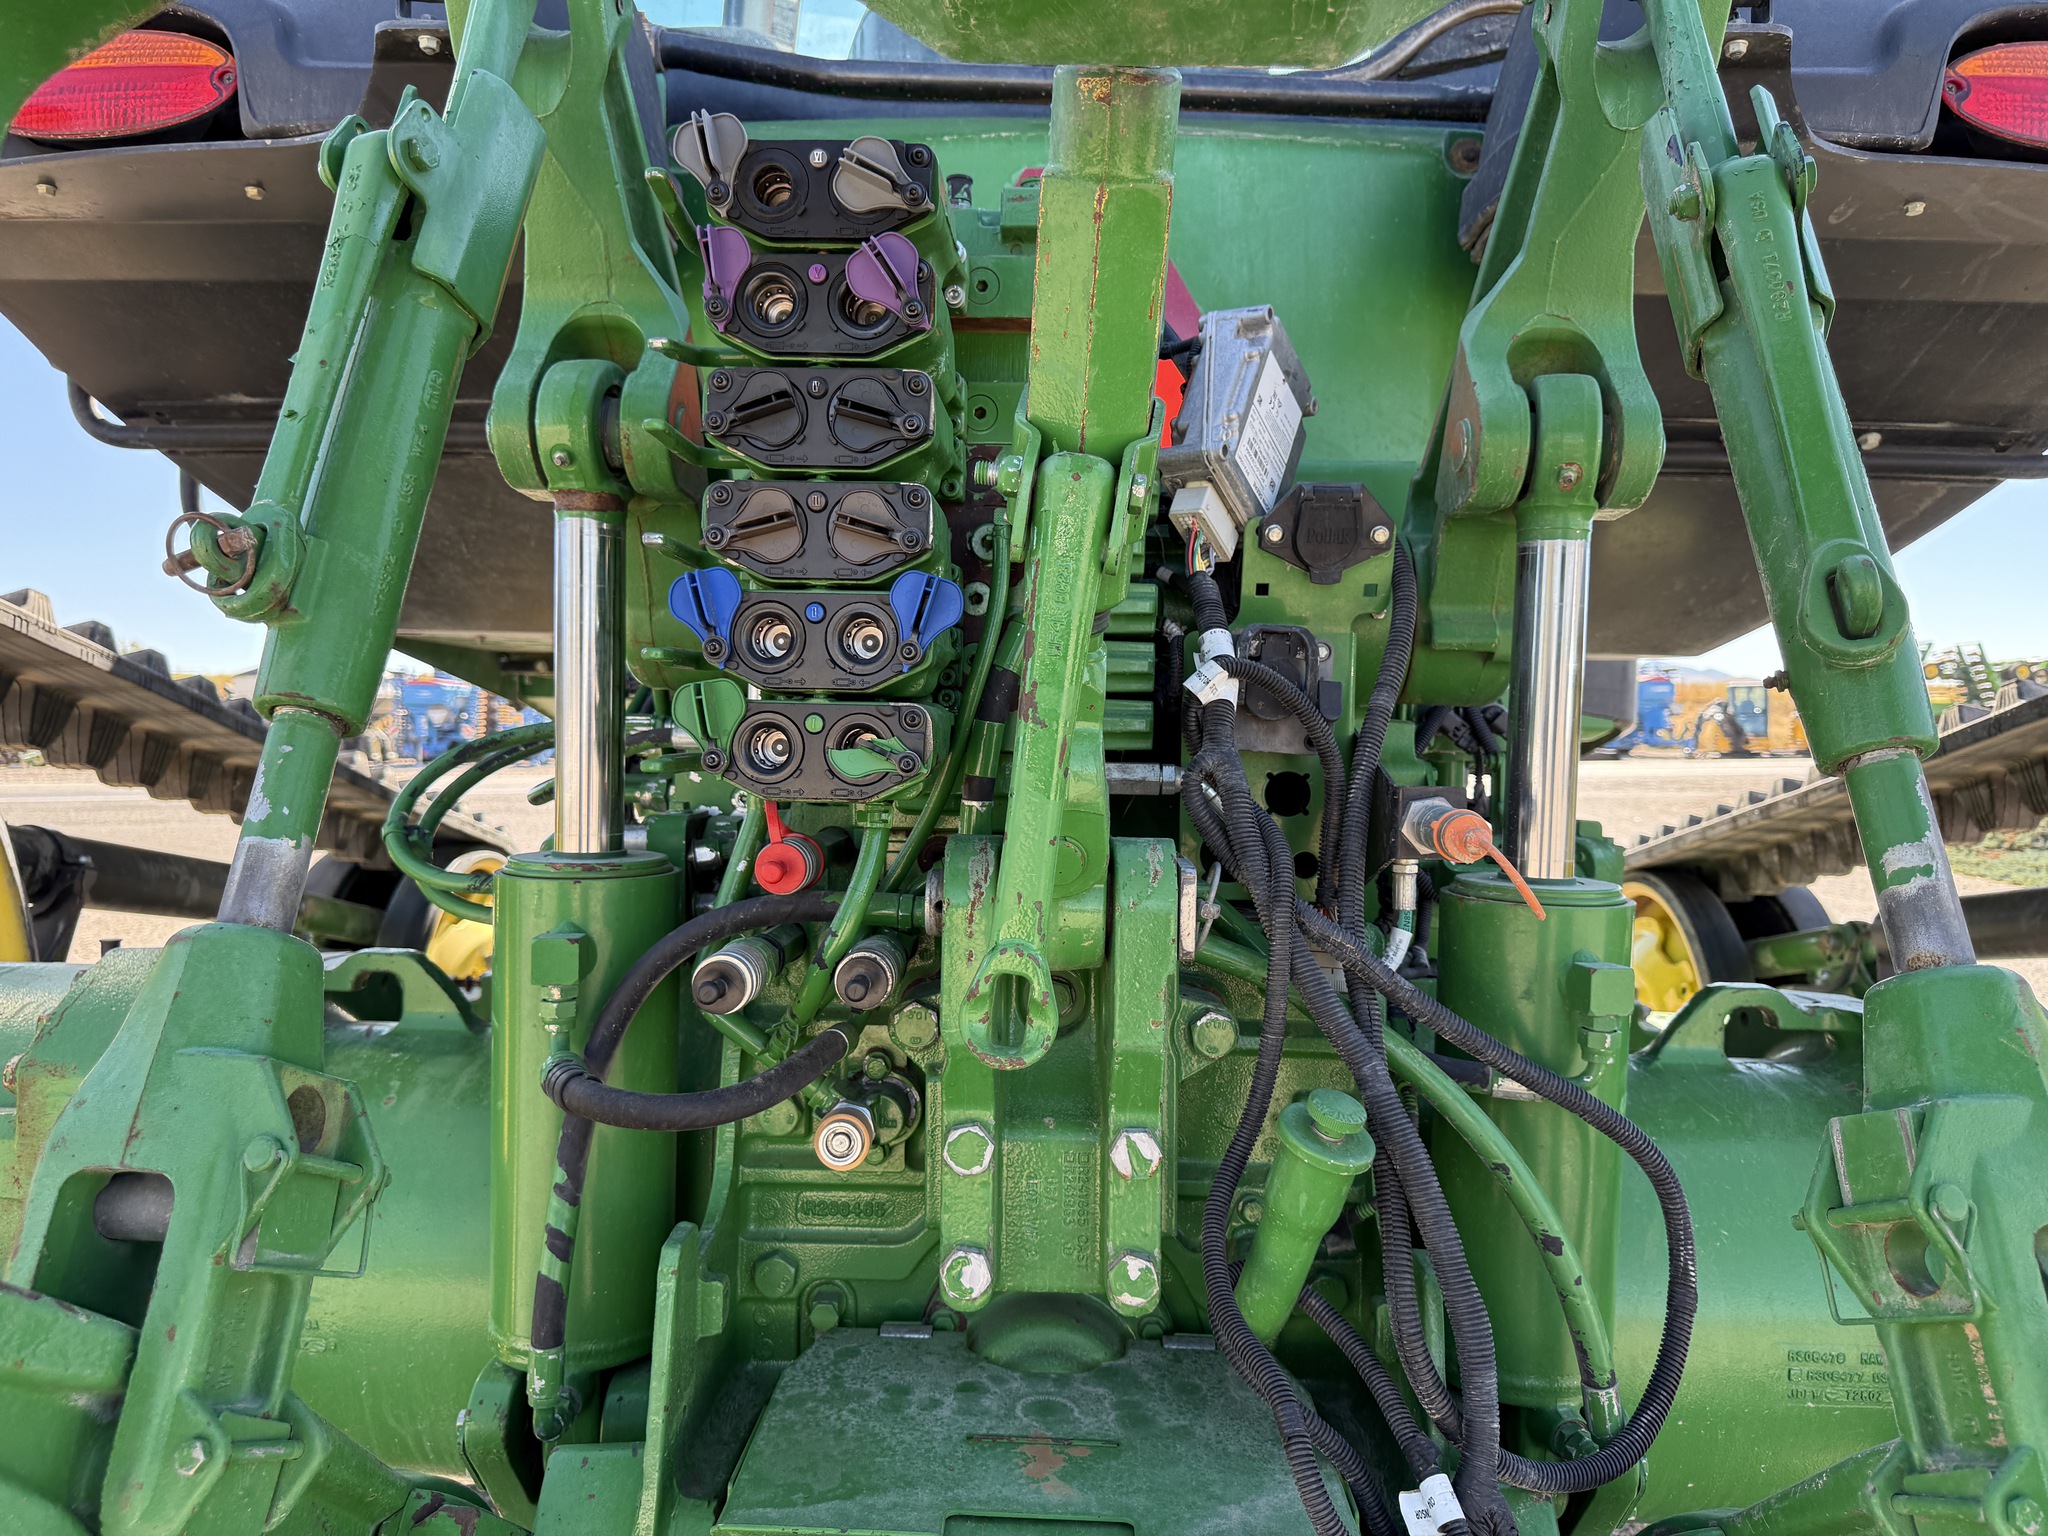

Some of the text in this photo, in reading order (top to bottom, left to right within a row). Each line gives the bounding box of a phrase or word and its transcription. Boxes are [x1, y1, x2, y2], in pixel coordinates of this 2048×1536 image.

[813, 152, 823, 163] VI
[1748, 190, 1769, 222] USA
[814, 267, 822, 279] V
[812, 495, 821, 507] III
[1306, 527, 1351, 544] Pollak
